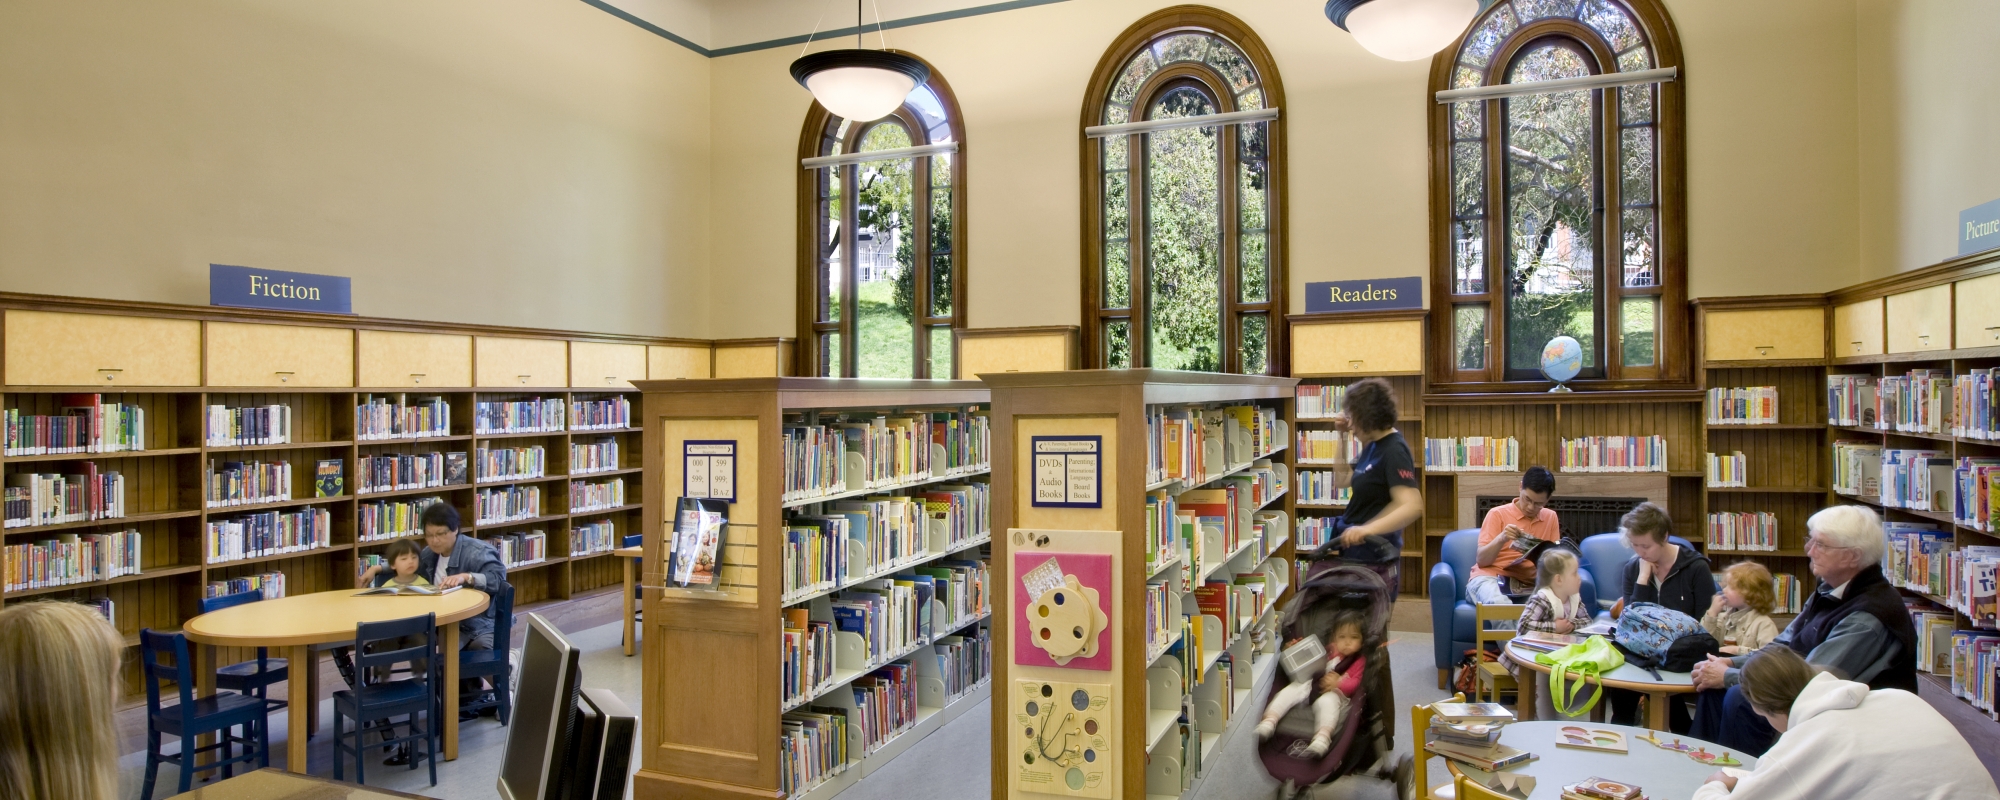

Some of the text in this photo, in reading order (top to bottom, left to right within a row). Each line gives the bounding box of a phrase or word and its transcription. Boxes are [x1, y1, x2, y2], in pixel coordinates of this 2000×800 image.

[1966, 219, 2000, 241] Picture
[249, 275, 320, 300] Fiction
[1330, 284, 1397, 302] Readers
[692, 459, 704, 467] 000
[716, 459, 727, 467] 599
[1040, 459, 1062, 467] DVDs
[1040, 478, 1062, 486] Audio
[1040, 490, 1062, 498] Books
